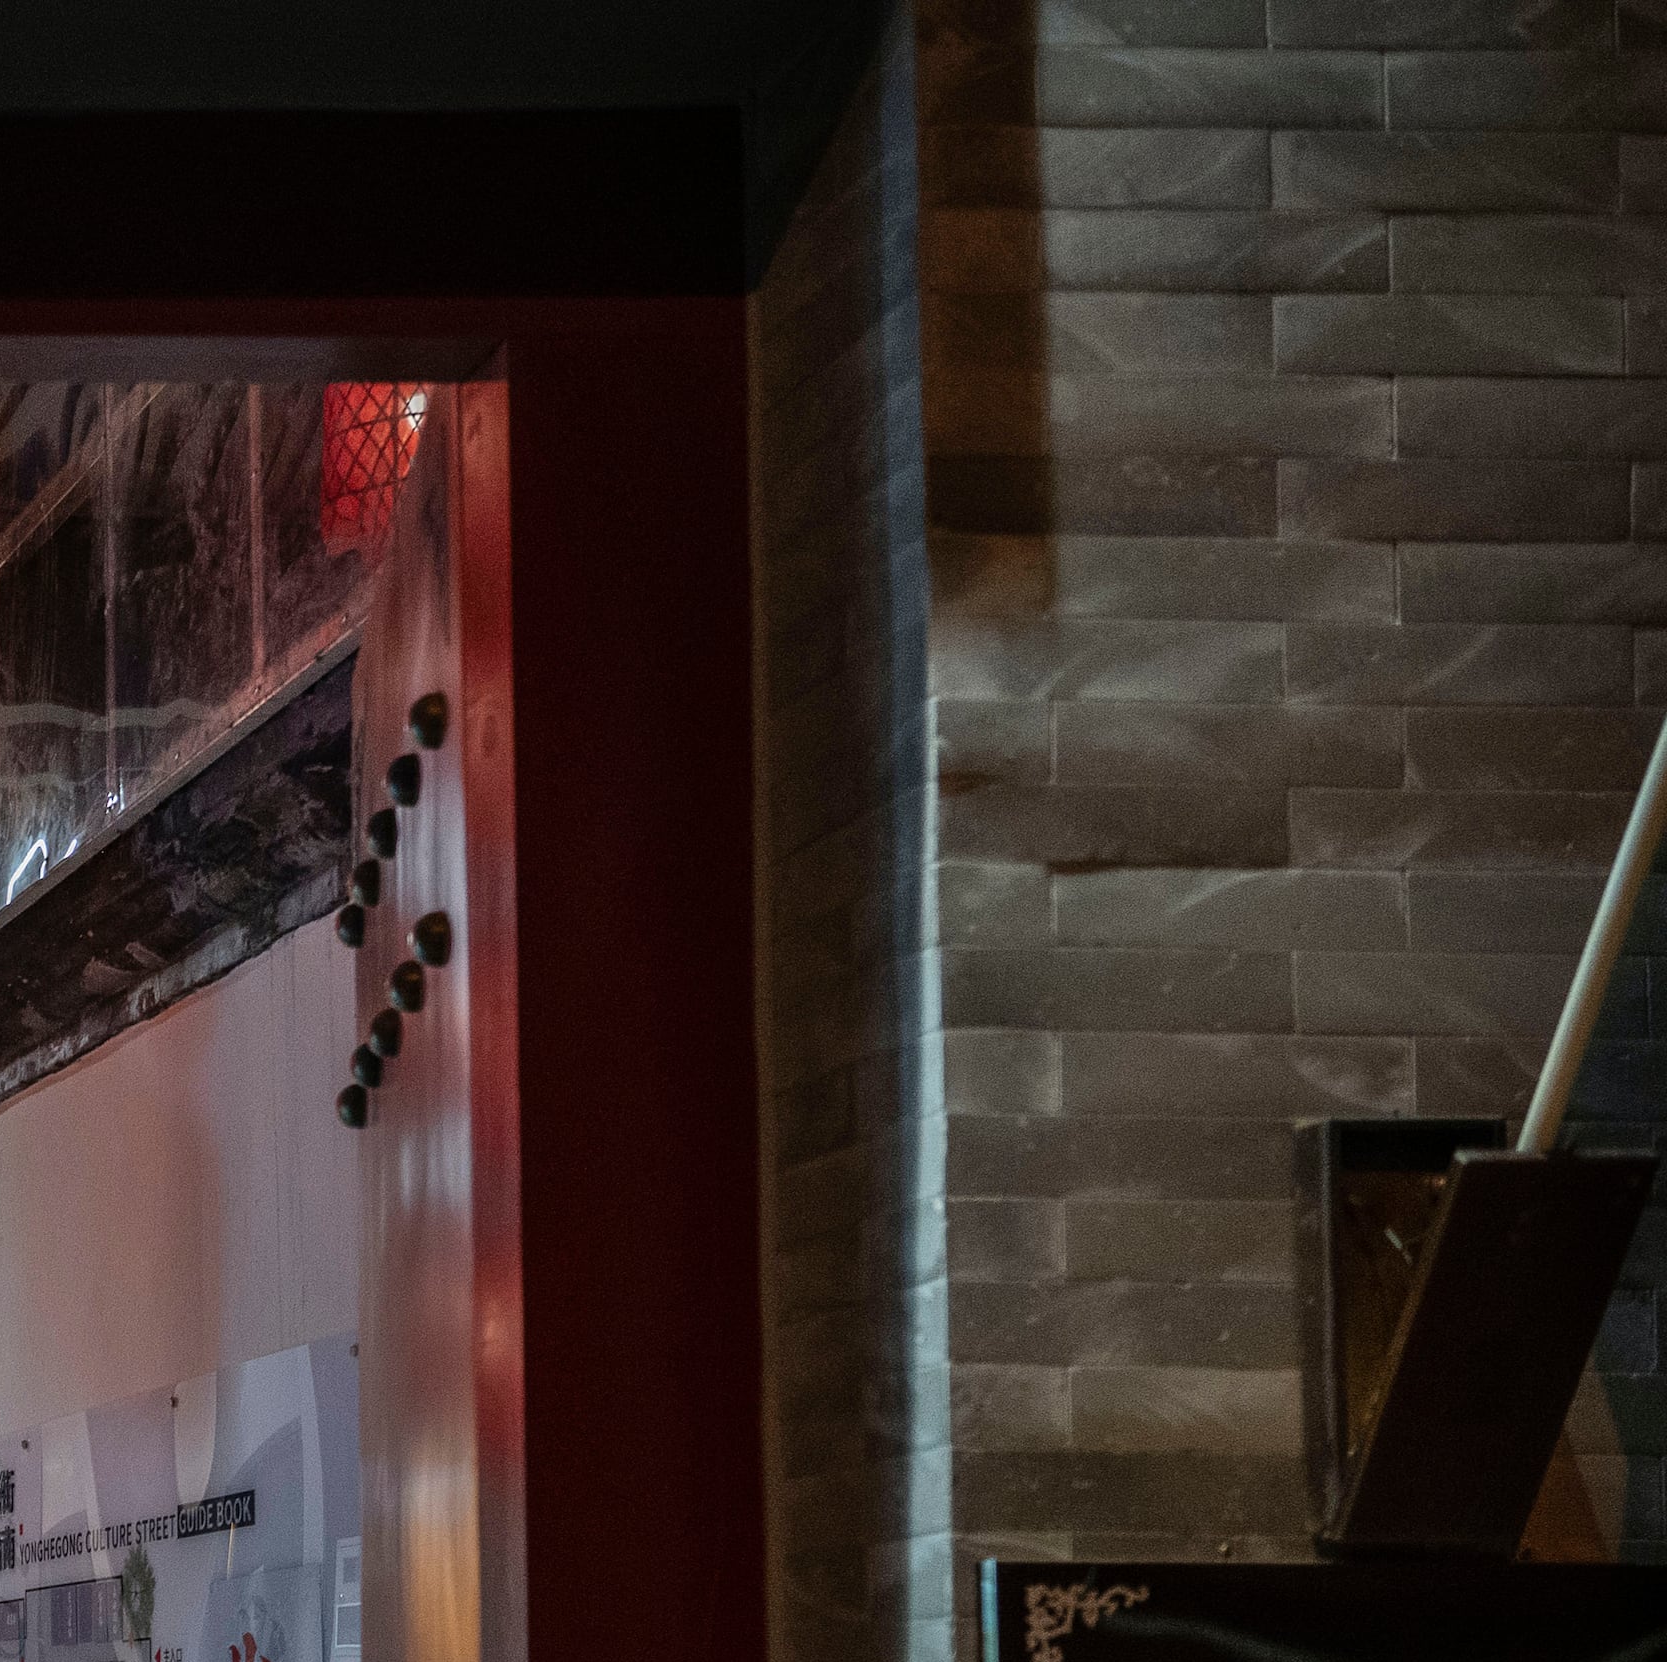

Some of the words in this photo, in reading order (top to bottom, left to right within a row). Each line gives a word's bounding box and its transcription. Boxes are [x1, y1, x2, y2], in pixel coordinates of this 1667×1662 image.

[19, 1532, 83, 1565] YONGHEGONG
[85, 1524, 132, 1552] CULTURE
[134, 1514, 176, 1545] STREET
[178, 1502, 213, 1535] GUIDE
[216, 1495, 253, 1527] BOOK
